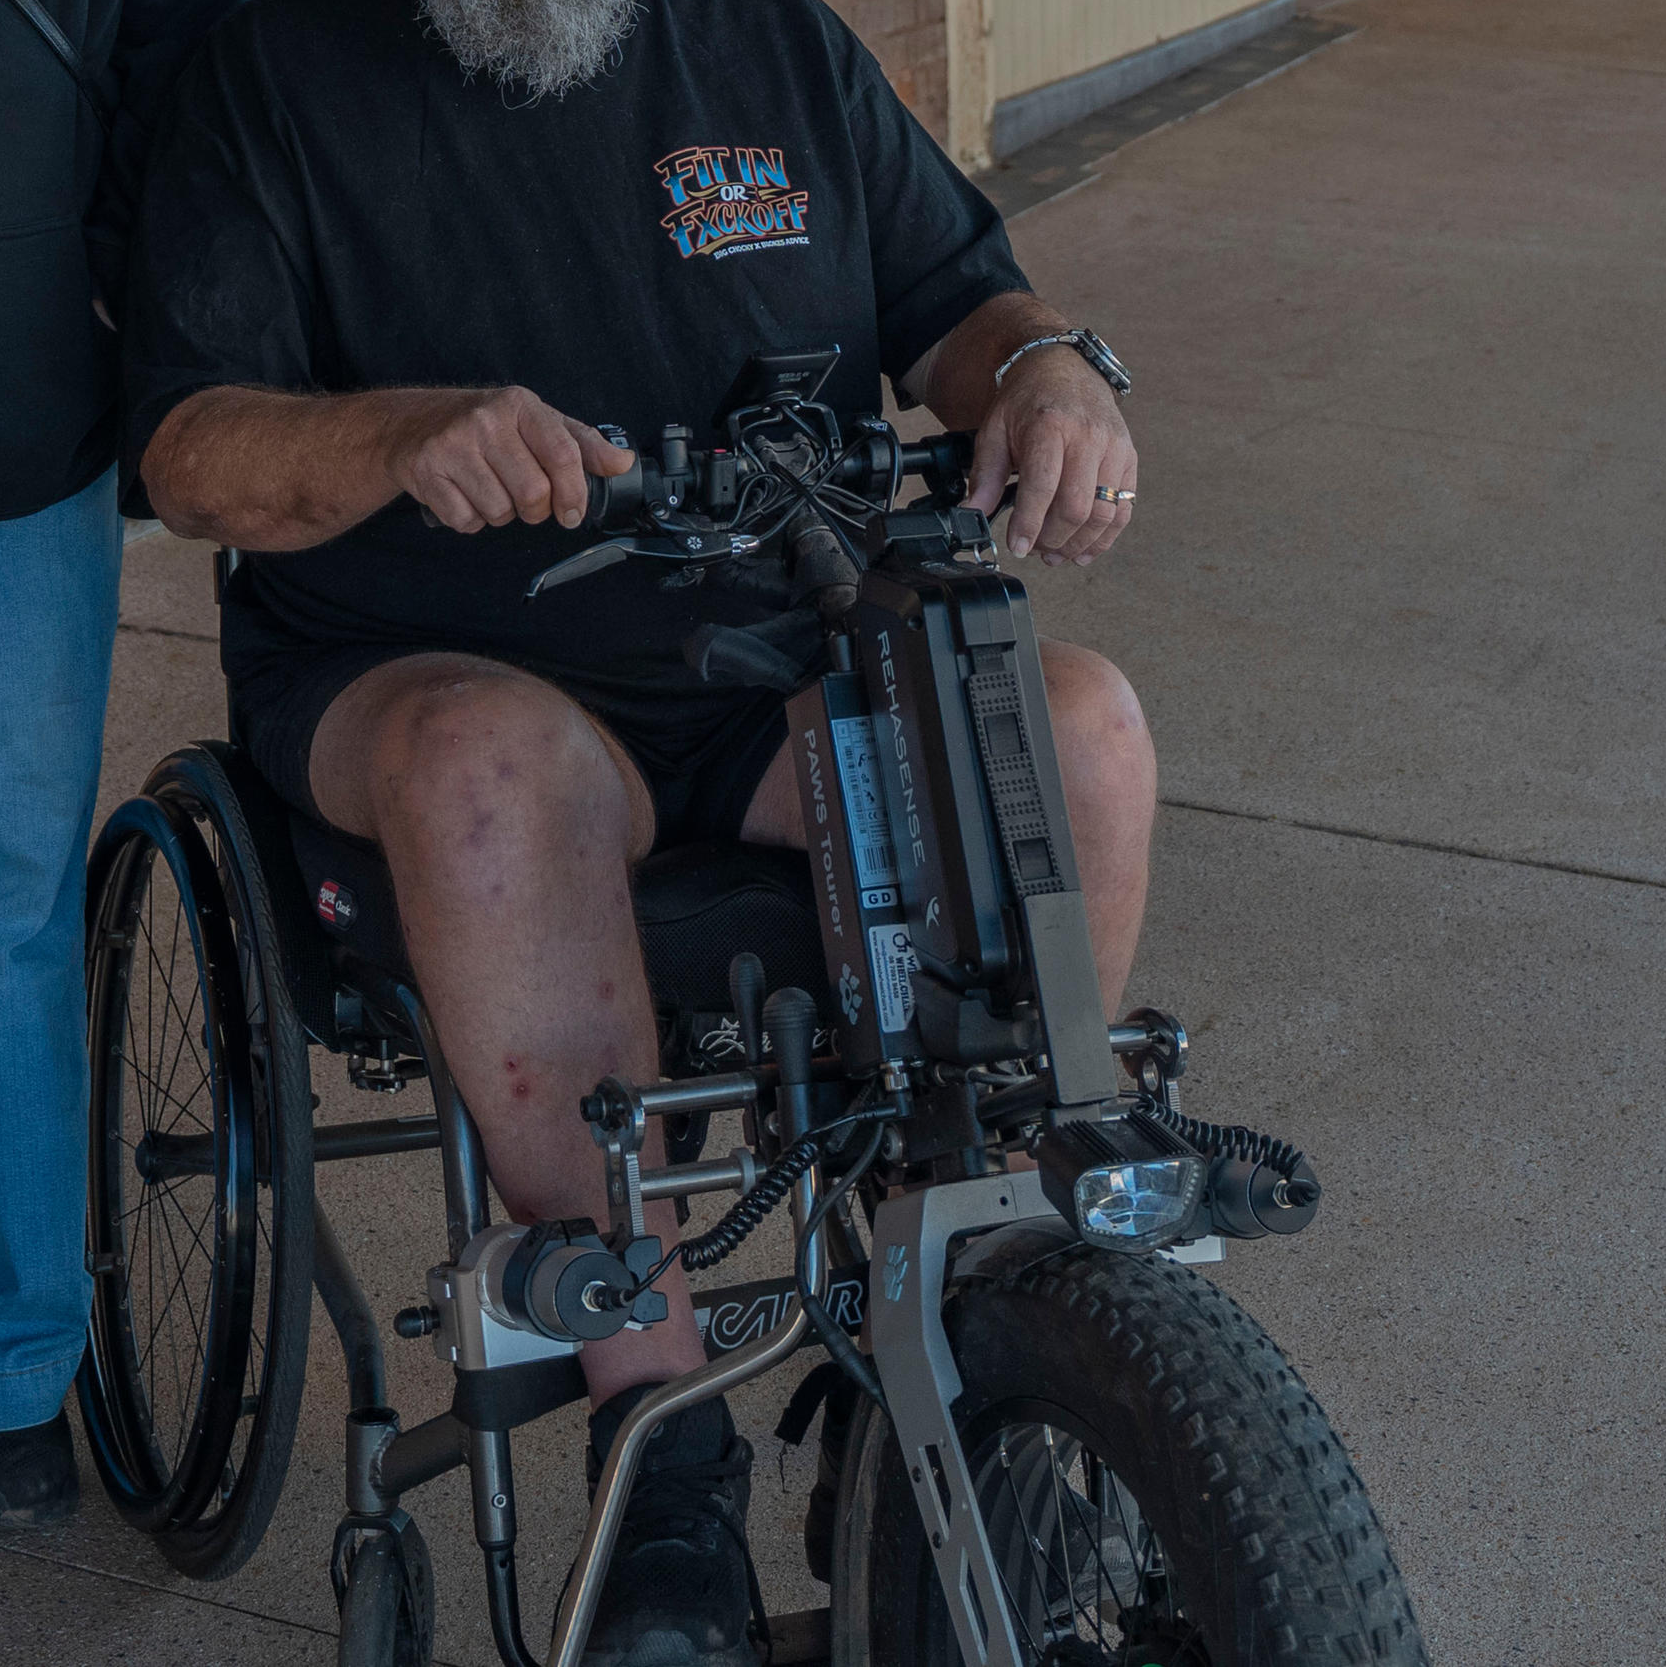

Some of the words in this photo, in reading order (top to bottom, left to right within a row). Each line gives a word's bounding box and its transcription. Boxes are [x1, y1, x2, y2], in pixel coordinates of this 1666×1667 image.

[720, 185, 749, 201] OR
[735, 147, 791, 189] IN
[877, 629, 925, 868] REHASENSE
[804, 728, 828, 824] PAWS
[820, 831, 844, 938] Tourer
